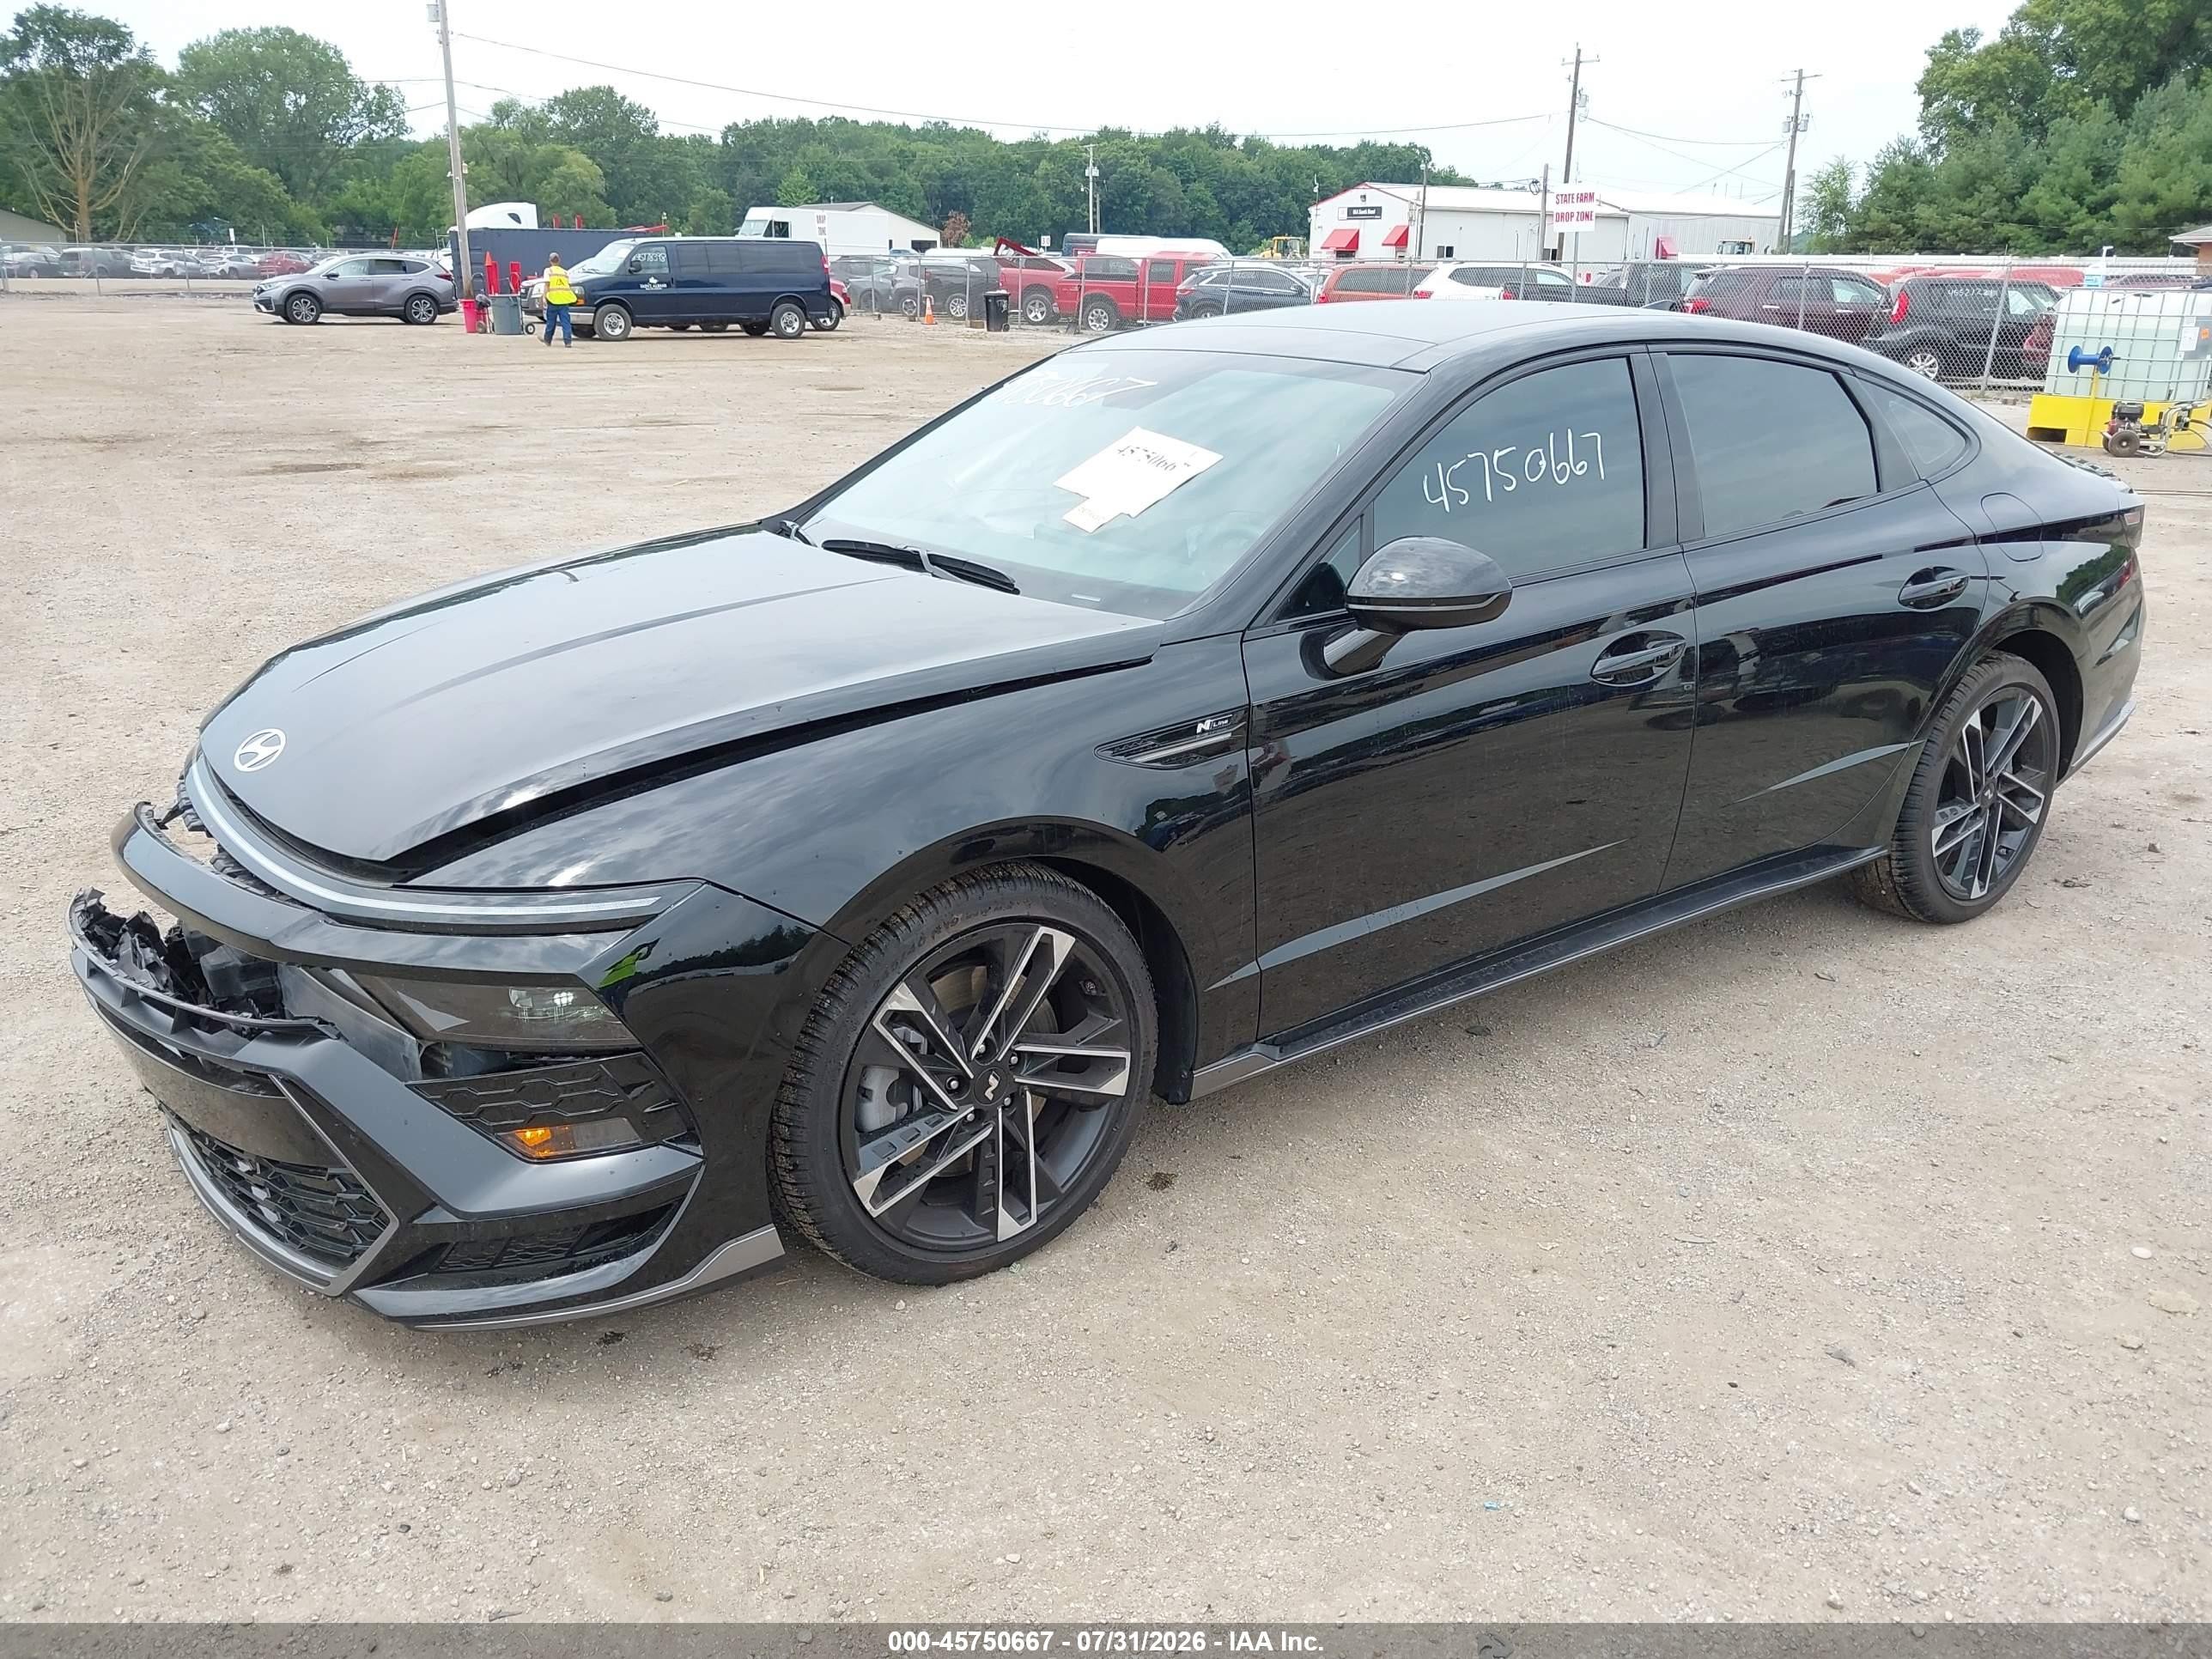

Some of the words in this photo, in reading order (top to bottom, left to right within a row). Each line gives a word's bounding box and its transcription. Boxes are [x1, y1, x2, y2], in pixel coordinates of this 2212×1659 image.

[1555, 193, 1575, 204] STATE
[1577, 192, 1595, 204] FARM
[1555, 211, 1574, 223] DROP
[1576, 210, 1594, 222] ZONE
[1422, 428, 1606, 514] 45750667
